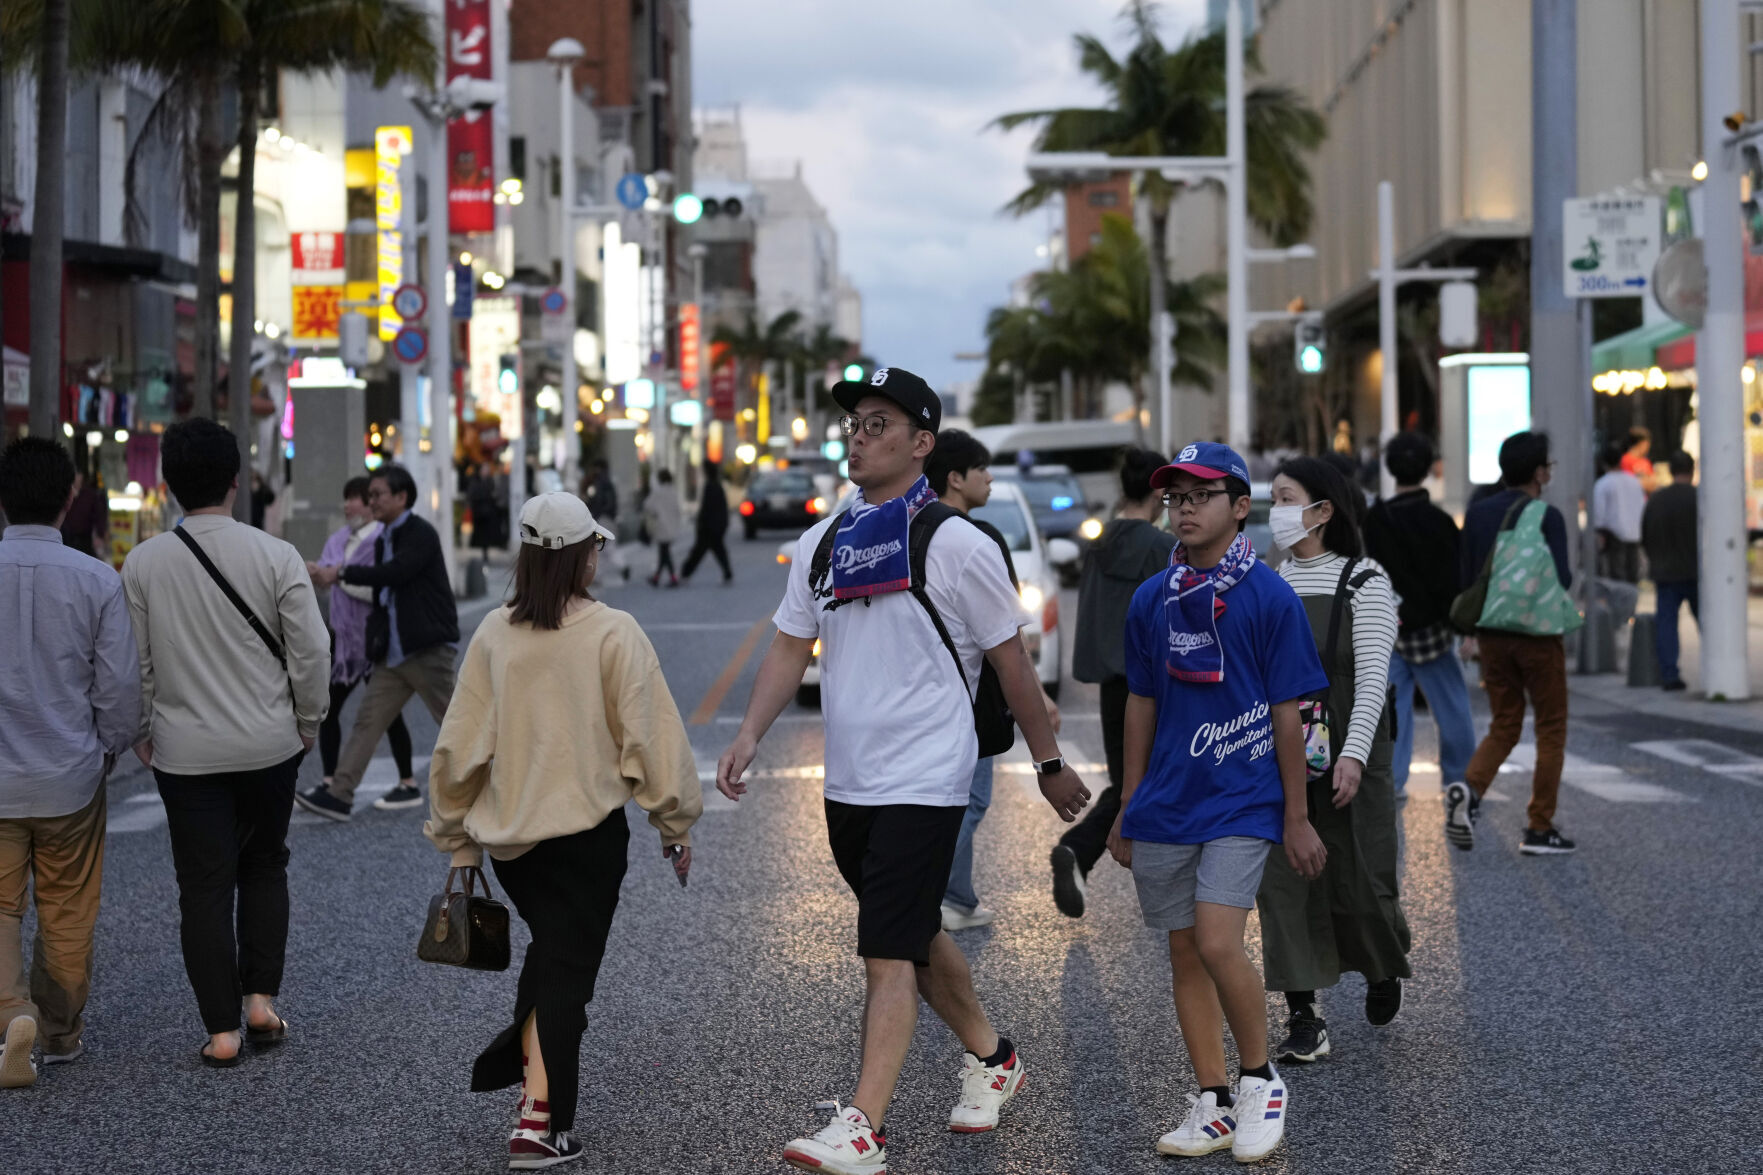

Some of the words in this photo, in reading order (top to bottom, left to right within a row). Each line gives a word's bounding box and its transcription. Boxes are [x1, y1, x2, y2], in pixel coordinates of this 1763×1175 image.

[835, 538, 903, 574] Dragons
[1168, 630, 1214, 656] ragons
[1213, 725, 1268, 766] Yomitan
